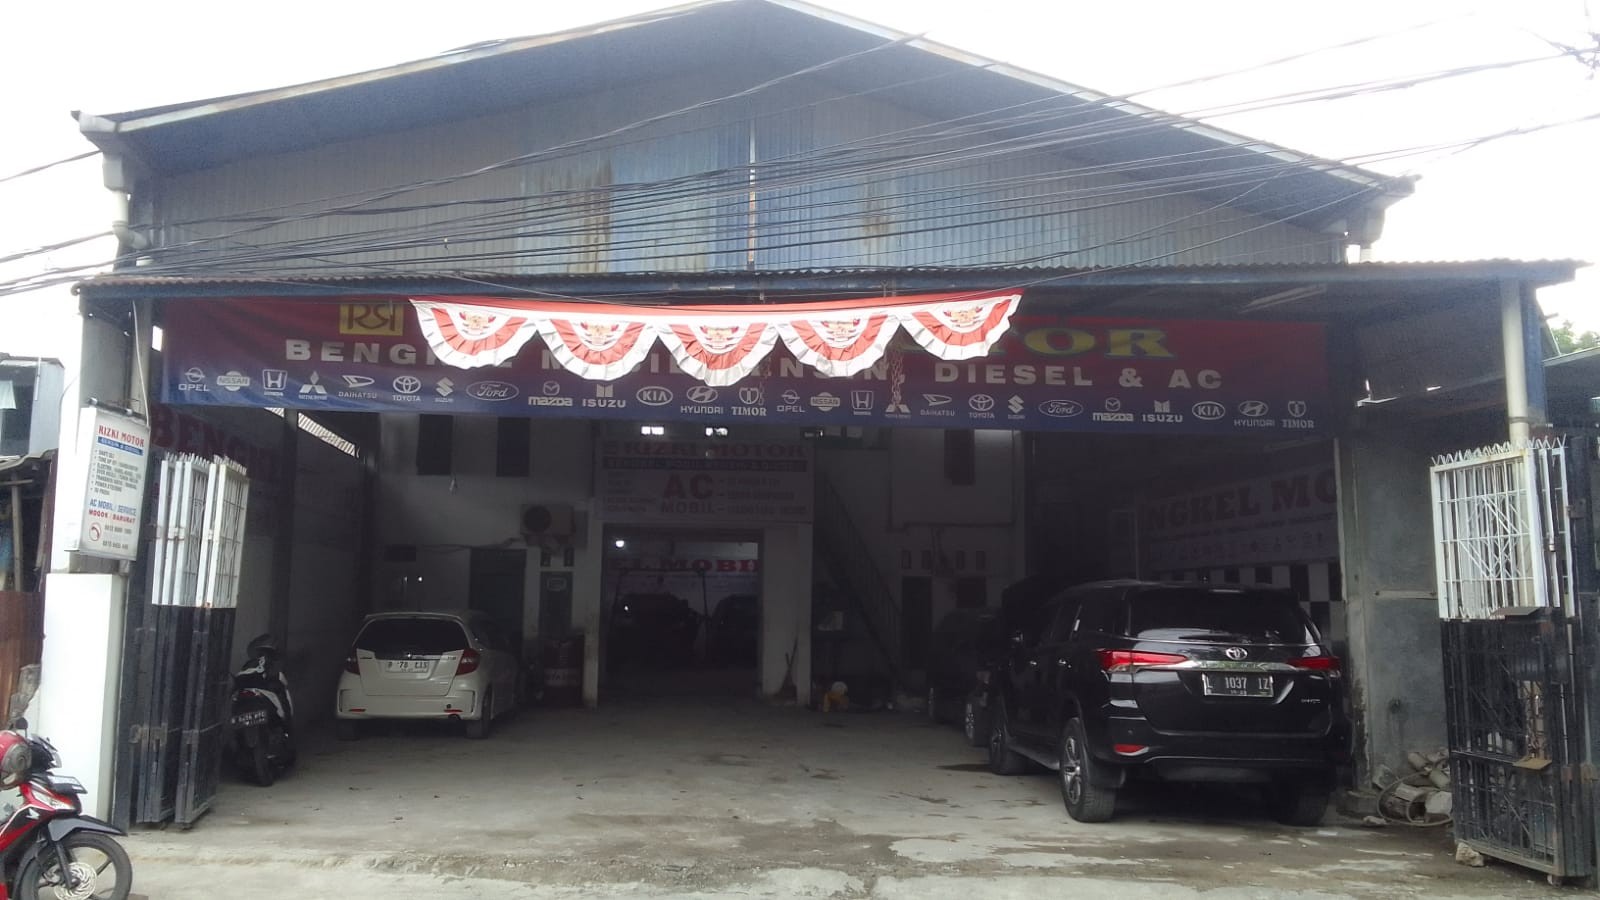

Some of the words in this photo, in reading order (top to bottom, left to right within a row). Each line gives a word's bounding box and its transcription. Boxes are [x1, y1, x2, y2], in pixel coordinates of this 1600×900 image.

[935, 362, 1094, 387] DIESEL
[1119, 368, 1143, 388] &
[1168, 369, 1222, 390] AC
[178, 383, 210, 392] OPEL
[476, 383, 509, 398] Ford
[338, 391, 377, 400] DAIHATSU
[392, 394, 421, 402] TOYOTA
[642, 390, 668, 401] KIA
[582, 398, 627, 409] ISUZU
[1047, 401, 1074, 415] Ford
[680, 405, 724, 415] HYUNDAI
[731, 406, 767, 416] TIMOR
[776, 405, 806, 413] OPEL
[920, 409, 955, 417] DAIHATSU
[1197, 405, 1221, 417] KIA
[1142, 414, 1184, 423] ISUZU
[1233, 419, 1275, 428] HYUNDAI
[1281, 419, 1315, 429] TIMOR
[121, 432, 145, 448] MOTOR
[663, 474, 714, 500] AC
[1225, 676, 1248, 689] 1037
